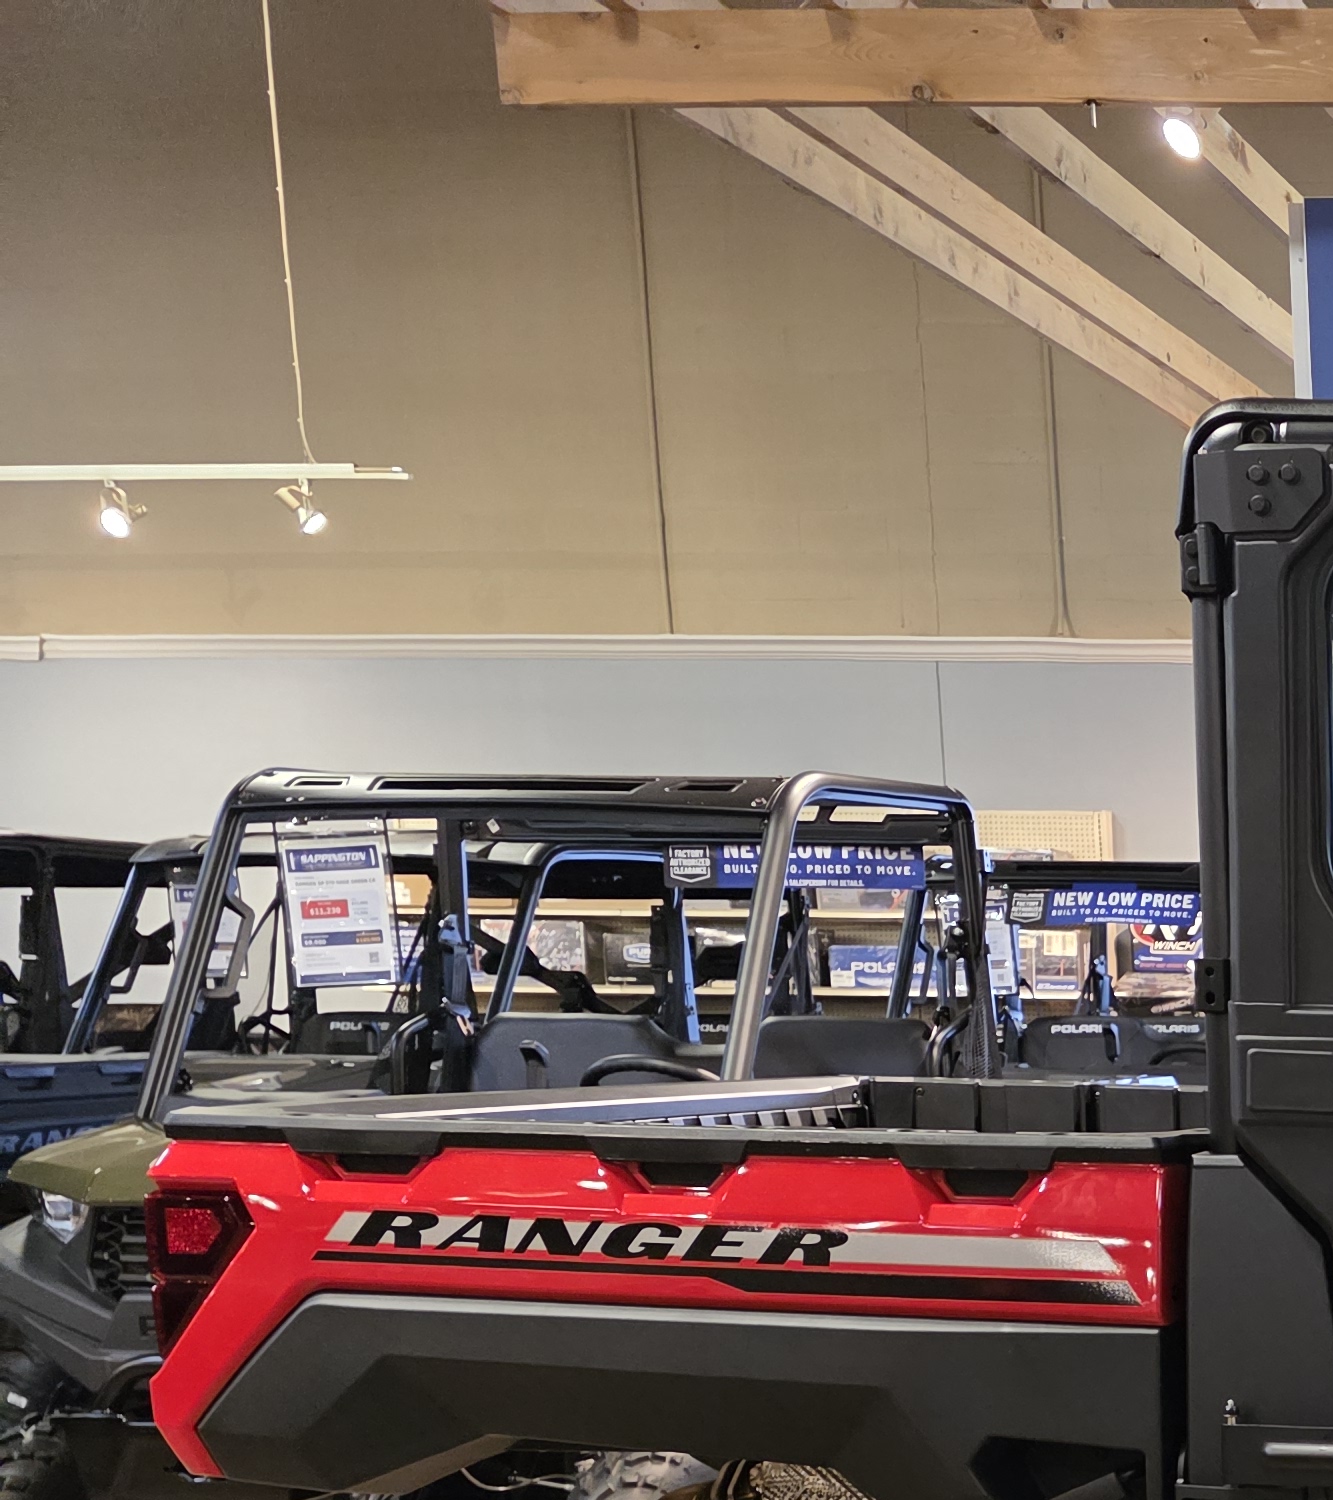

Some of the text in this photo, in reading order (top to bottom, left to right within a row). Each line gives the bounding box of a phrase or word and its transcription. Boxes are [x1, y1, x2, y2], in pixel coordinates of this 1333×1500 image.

[674, 850, 704, 858] FACTORY
[788, 846, 832, 859] OW
[724, 864, 759, 874] BUILT
[806, 864, 851, 874] PRICED
[855, 865, 872, 875] TO
[876, 865, 916, 876] MOVE.
[1053, 892, 1195, 909] NEW LOW PRICE
[1051, 908, 1077, 917] BUILT
[1112, 908, 1146, 916] PRICED
[1149, 909, 1160, 917] TO
[1163, 910, 1192, 919] MOVE.
[1153, 941, 1196, 951] WINCH
[1050, 1024, 1103, 1034] POLARI
[1151, 1024, 1200, 1034] OLARIS
[348, 1209, 848, 1266] RANGER
